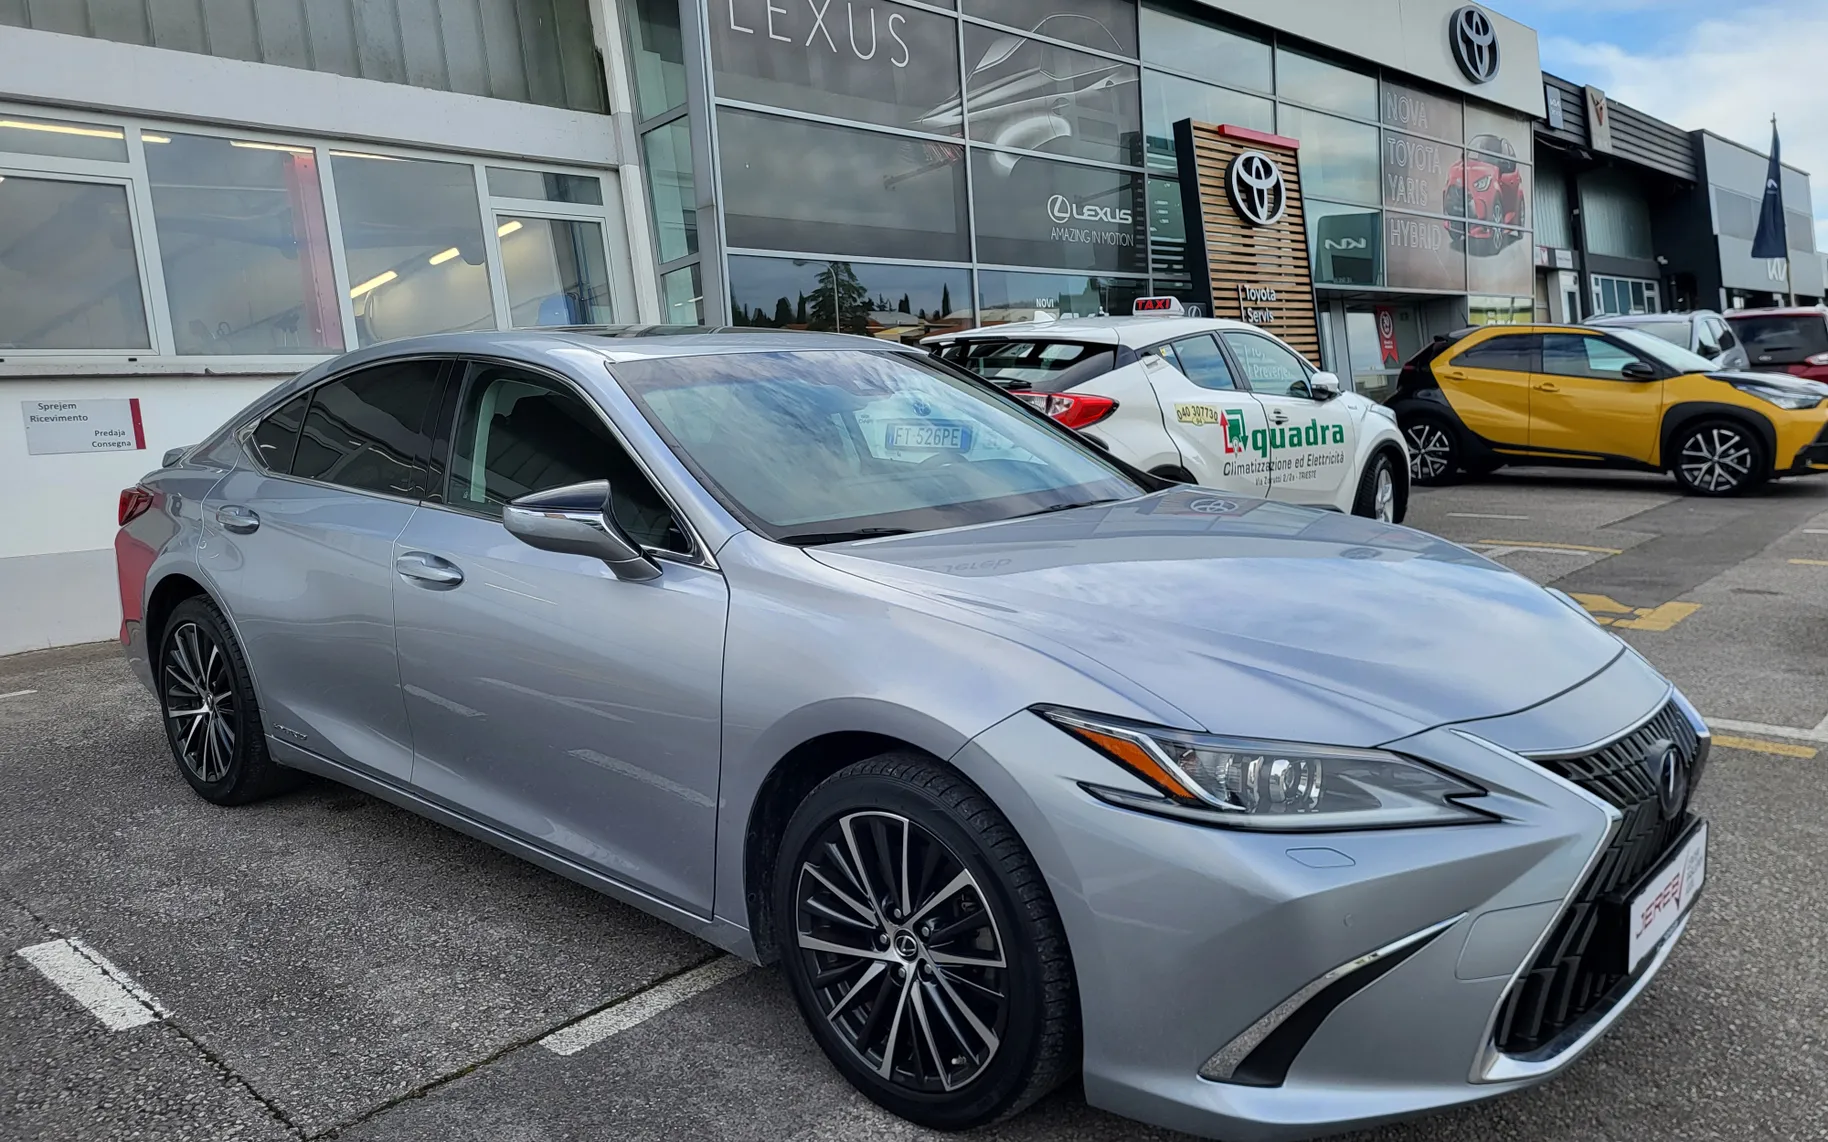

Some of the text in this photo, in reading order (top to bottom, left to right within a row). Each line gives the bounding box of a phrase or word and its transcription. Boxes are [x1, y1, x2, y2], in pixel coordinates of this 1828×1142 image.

[728, 0, 909, 67] LEXUS
[1387, 92, 1428, 129] NOVA
[1387, 137, 1442, 175] TOYOTA
[1388, 173, 1428, 206] YARIS
[1072, 203, 1132, 224] LEXUS
[1051, 227, 1134, 247] AMAZING IN MOTION
[1390, 218, 1441, 250] HYBRID
[1036, 298, 1054, 308] NOVI
[1244, 285, 1277, 303] Toyota
[1136, 299, 1171, 310] TAXI
[1247, 308, 1275, 323] Servis
[38, 402, 77, 411] Sprejem
[1177, 406, 1190, 420] 040
[1192, 406, 1218, 421] 307730
[30, 414, 88, 423] Ricevimento
[92, 441, 131, 449] Consegna
[895, 427, 959, 446] FT 526PE
[1252, 418, 1344, 458] quadra
[1223, 451, 1344, 477] Climatizzazione ed Elettricità
